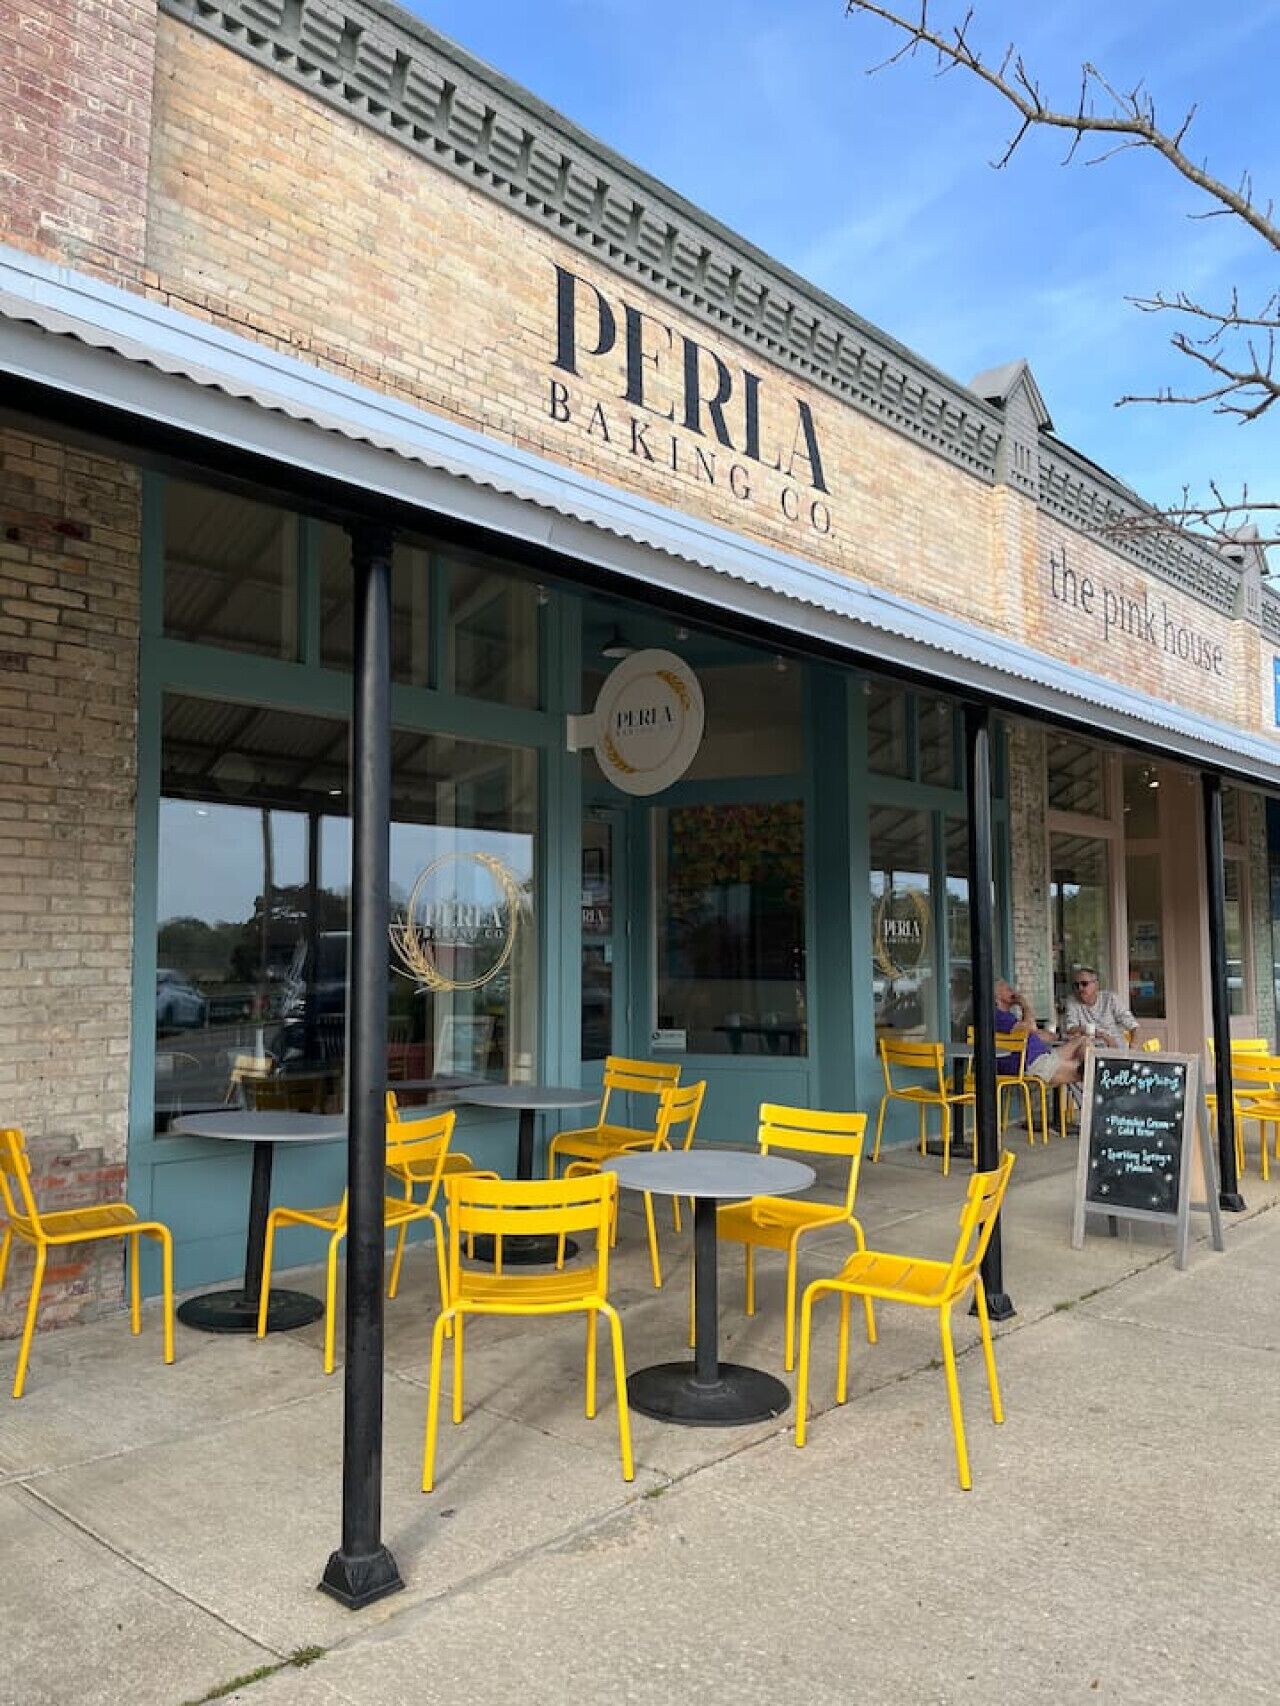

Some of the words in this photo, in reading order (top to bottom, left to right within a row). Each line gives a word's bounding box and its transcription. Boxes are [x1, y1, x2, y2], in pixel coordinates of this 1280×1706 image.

[550, 262, 830, 496] PERLA
[549, 379, 751, 501] BAKING
[781, 486, 836, 538] CO.
[1050, 545, 1095, 614] the
[1103, 585, 1157, 644] pink
[1163, 600, 1224, 676] house
[884, 919, 921, 937] PERLA
